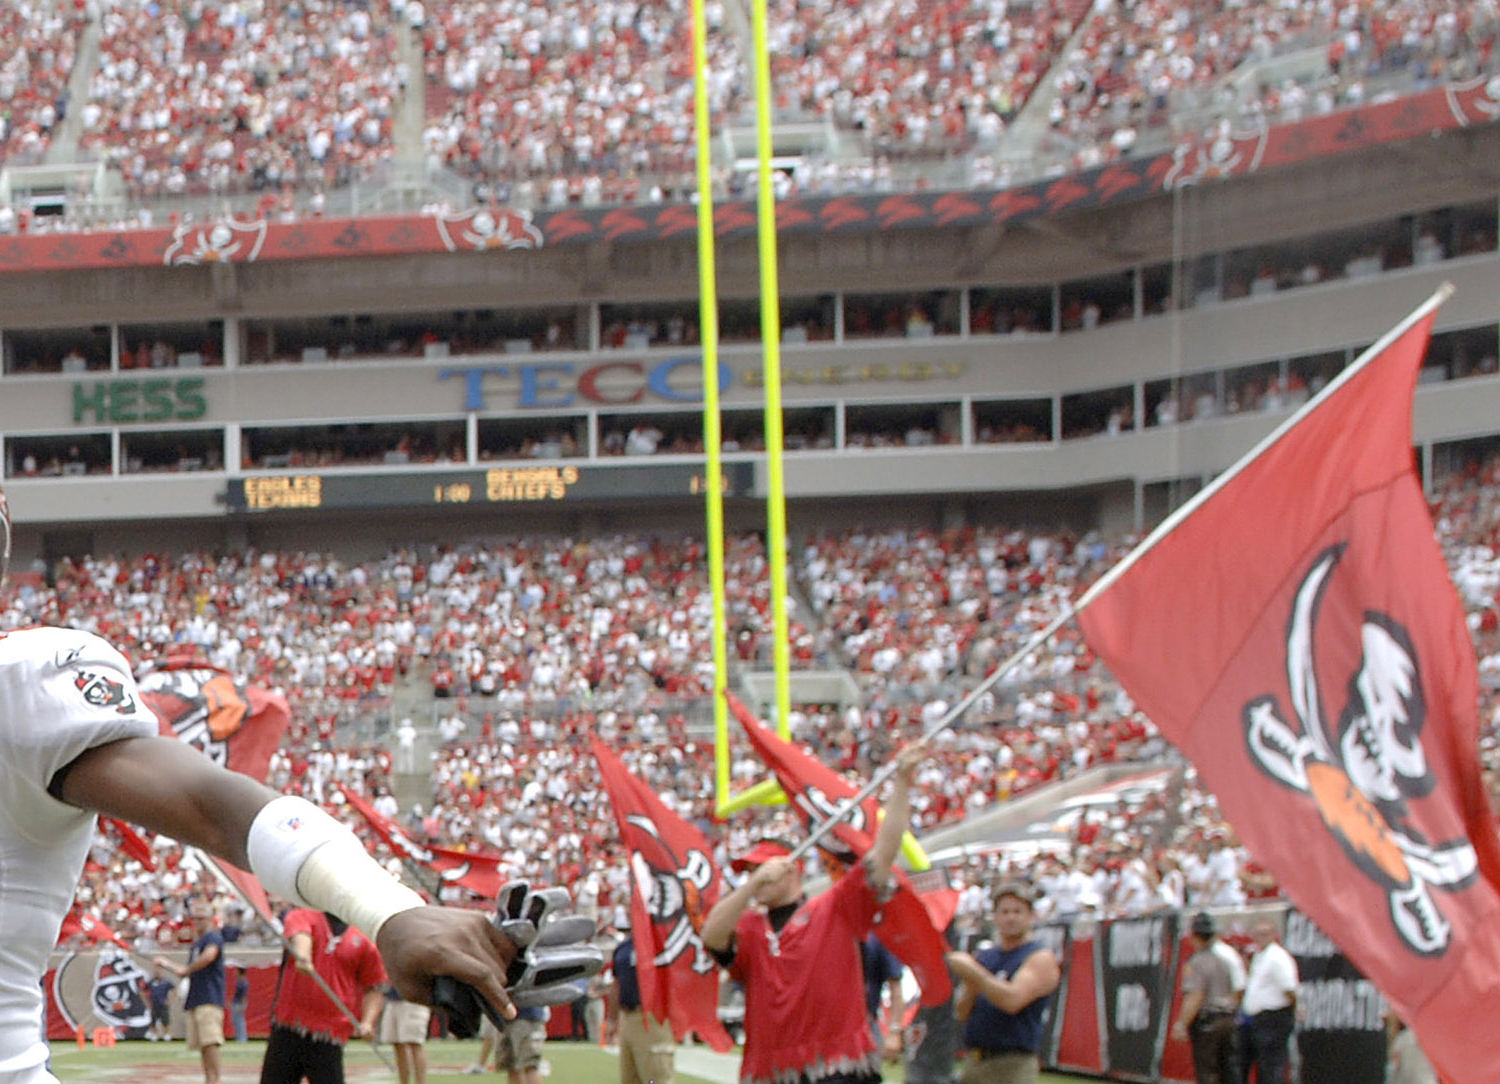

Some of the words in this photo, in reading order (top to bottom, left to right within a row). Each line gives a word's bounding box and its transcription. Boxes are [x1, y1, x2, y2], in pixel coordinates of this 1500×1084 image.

[73, 376, 207, 423] HESS
[439, 357, 732, 410] TECO
[486, 482, 567, 501] CHIEFS
